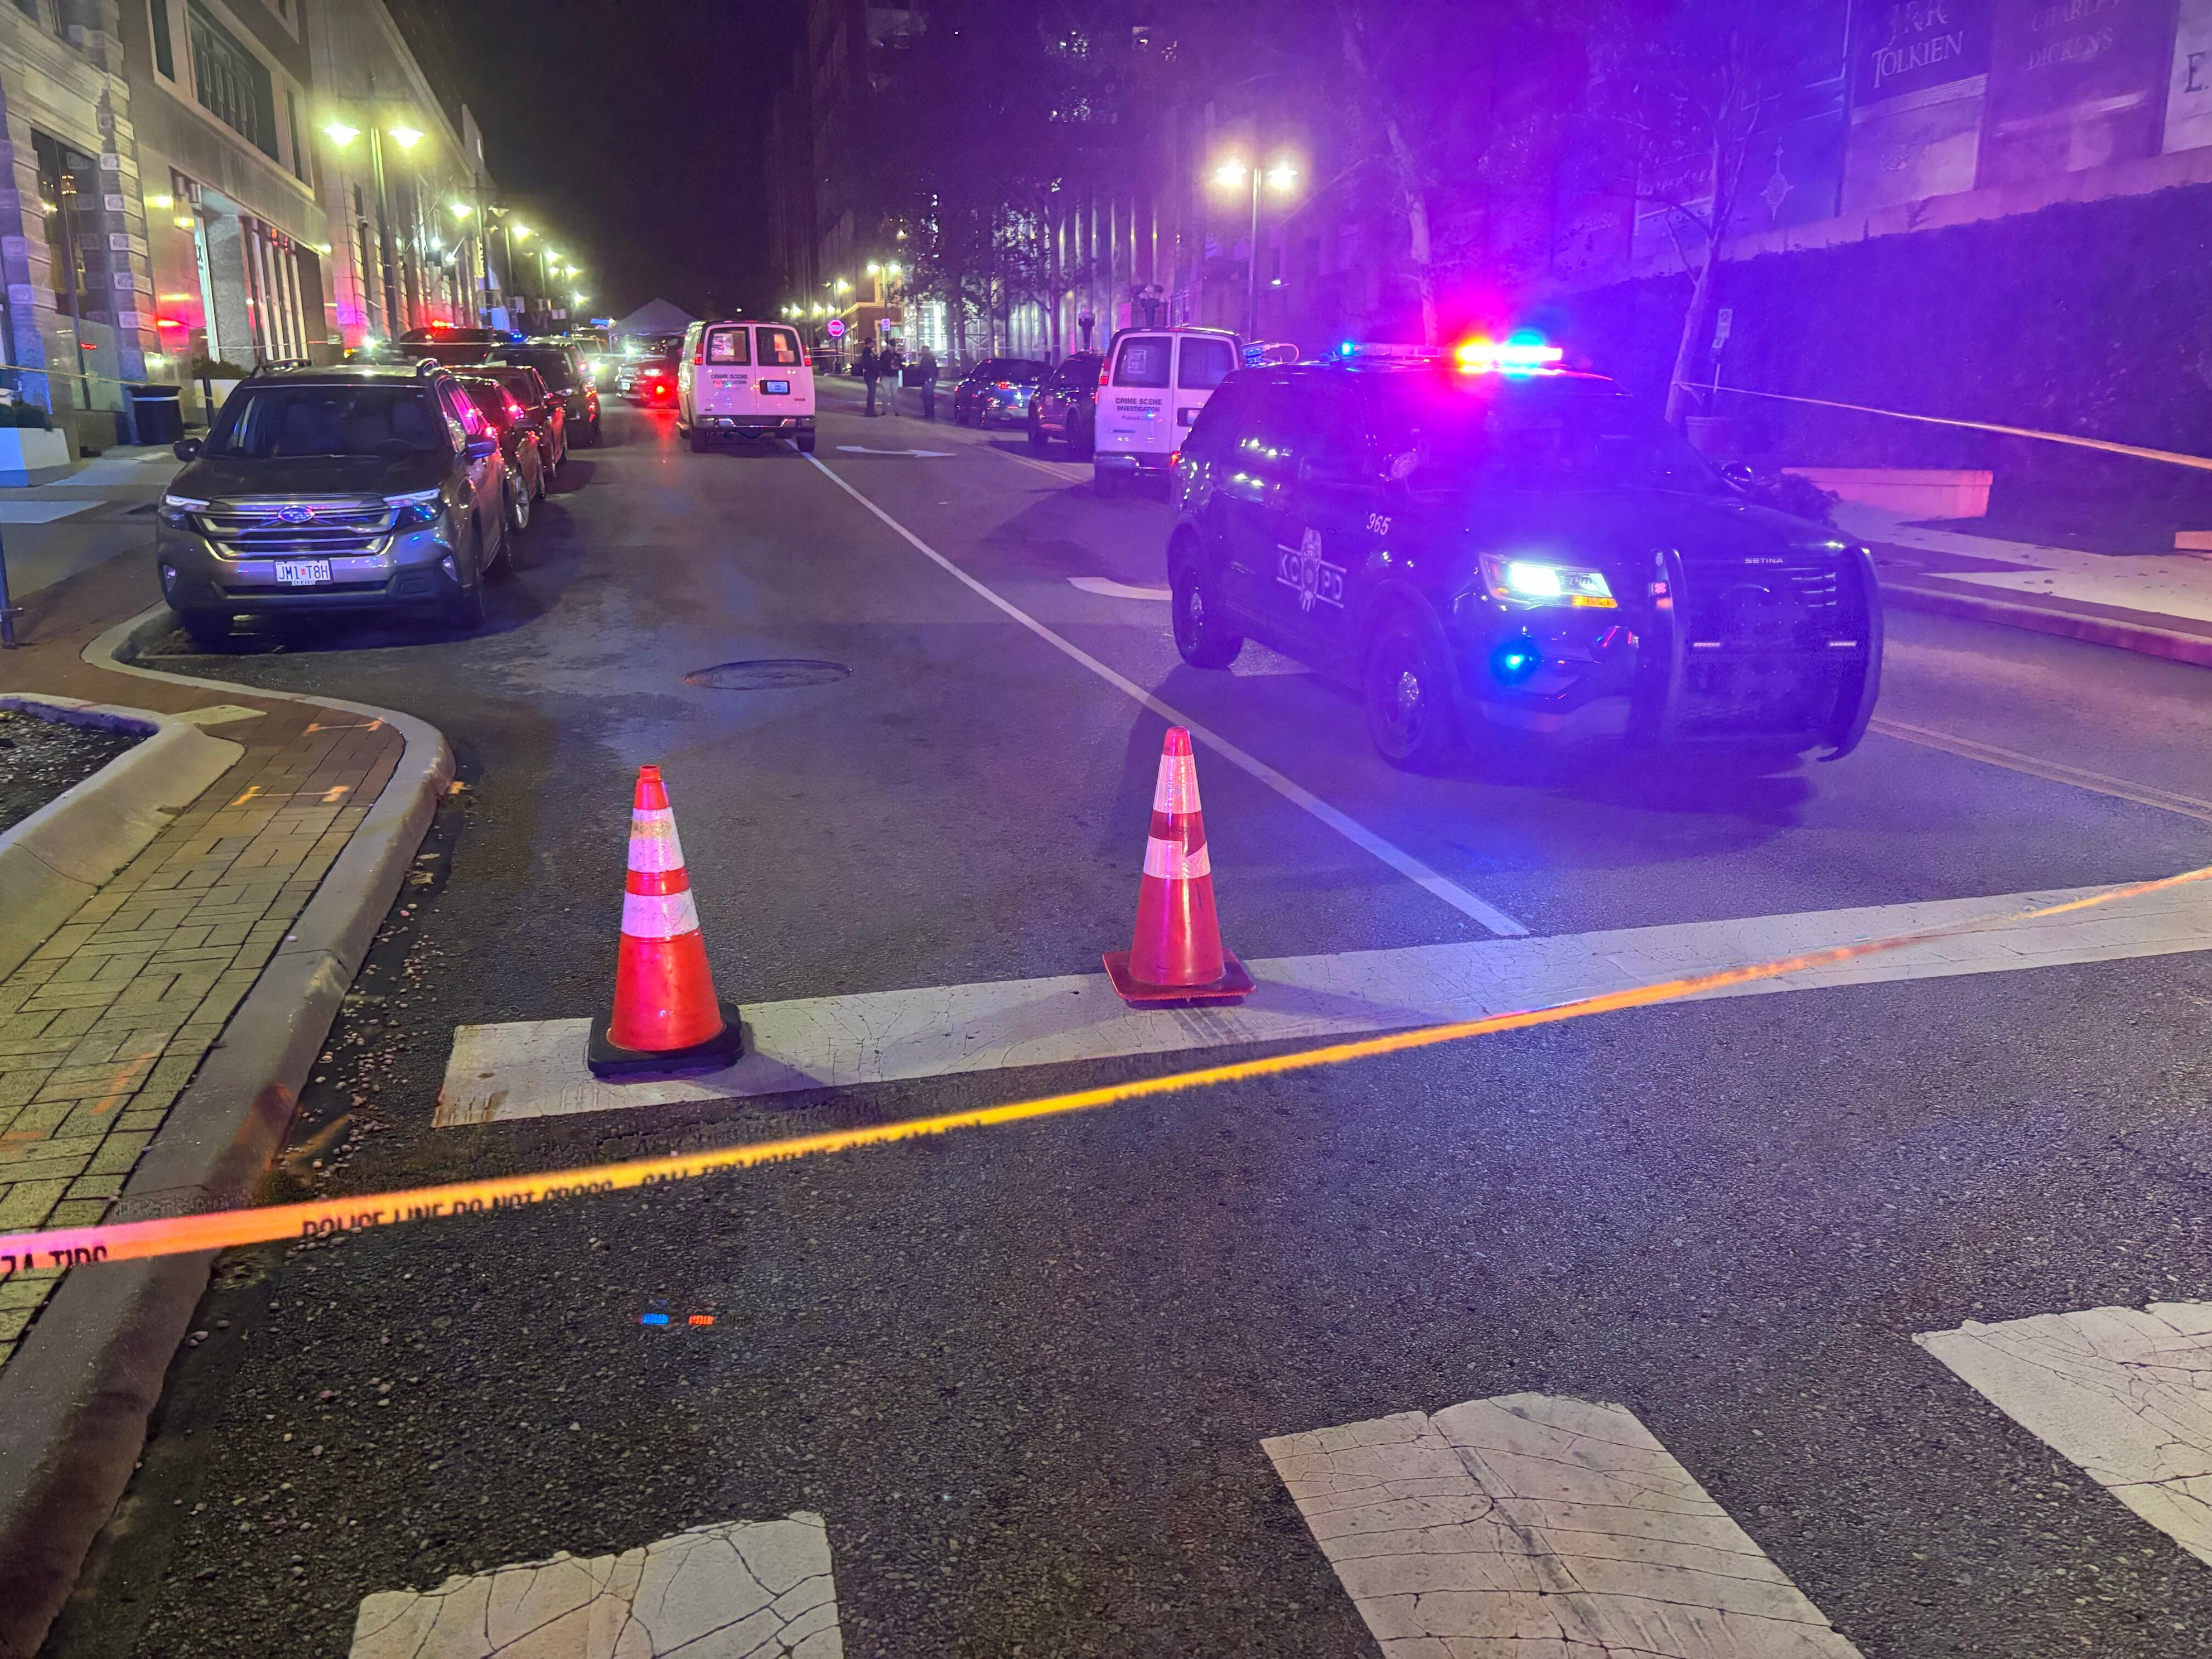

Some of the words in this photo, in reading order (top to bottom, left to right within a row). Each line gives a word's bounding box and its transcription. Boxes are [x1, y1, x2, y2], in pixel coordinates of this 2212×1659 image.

[1872, 31, 1963, 89] TOLKIEN
[1366, 513, 1391, 536] 965
[279, 566, 300, 580] JM1
[306, 565, 329, 579] T8H
